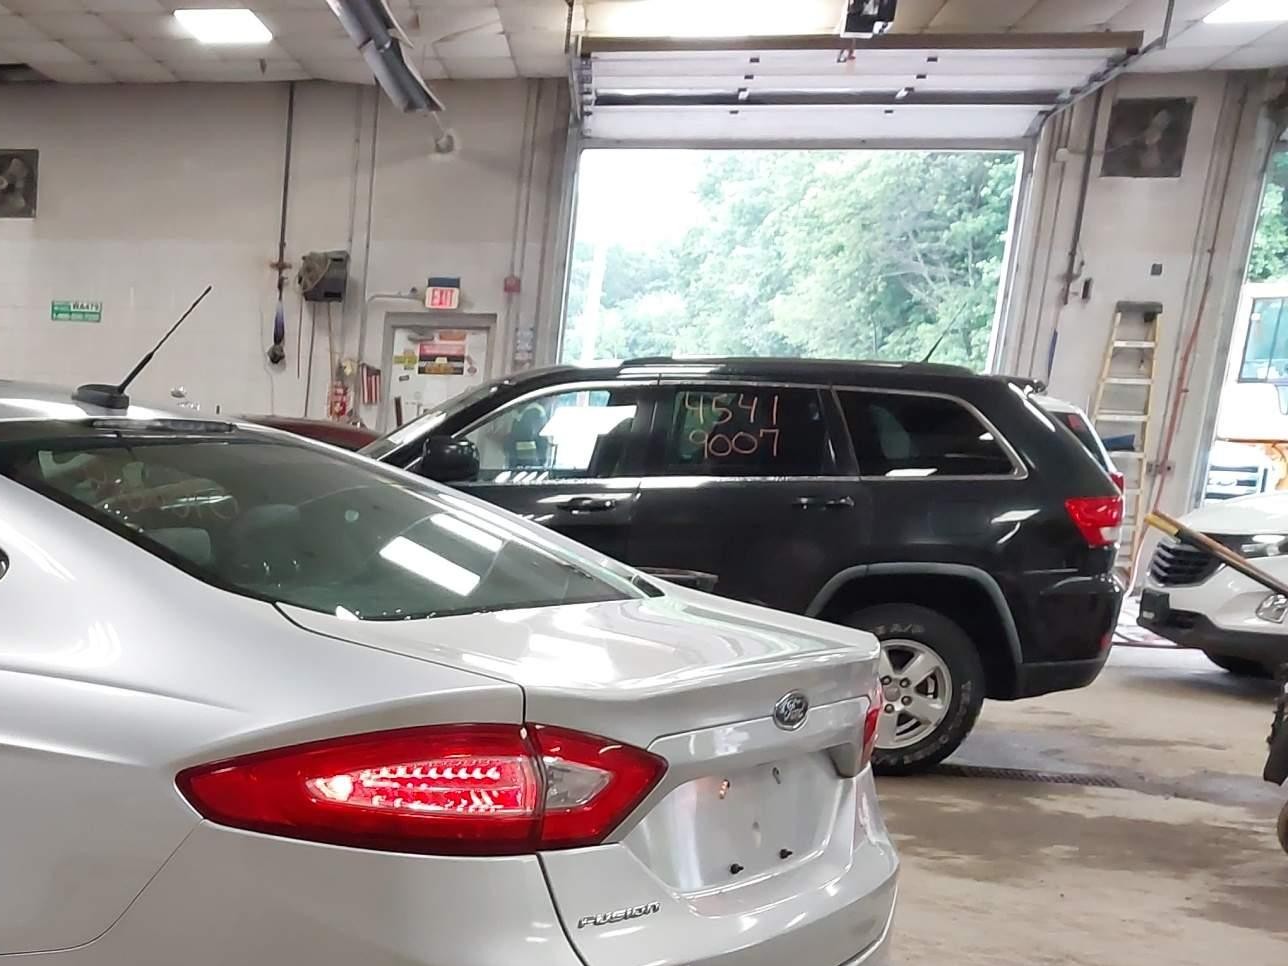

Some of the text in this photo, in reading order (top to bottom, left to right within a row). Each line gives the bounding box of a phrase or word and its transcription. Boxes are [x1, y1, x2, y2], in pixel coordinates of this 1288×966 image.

[430, 287, 455, 307] EXIT
[684, 391, 779, 426] 4541
[688, 428, 780, 459] 9007
